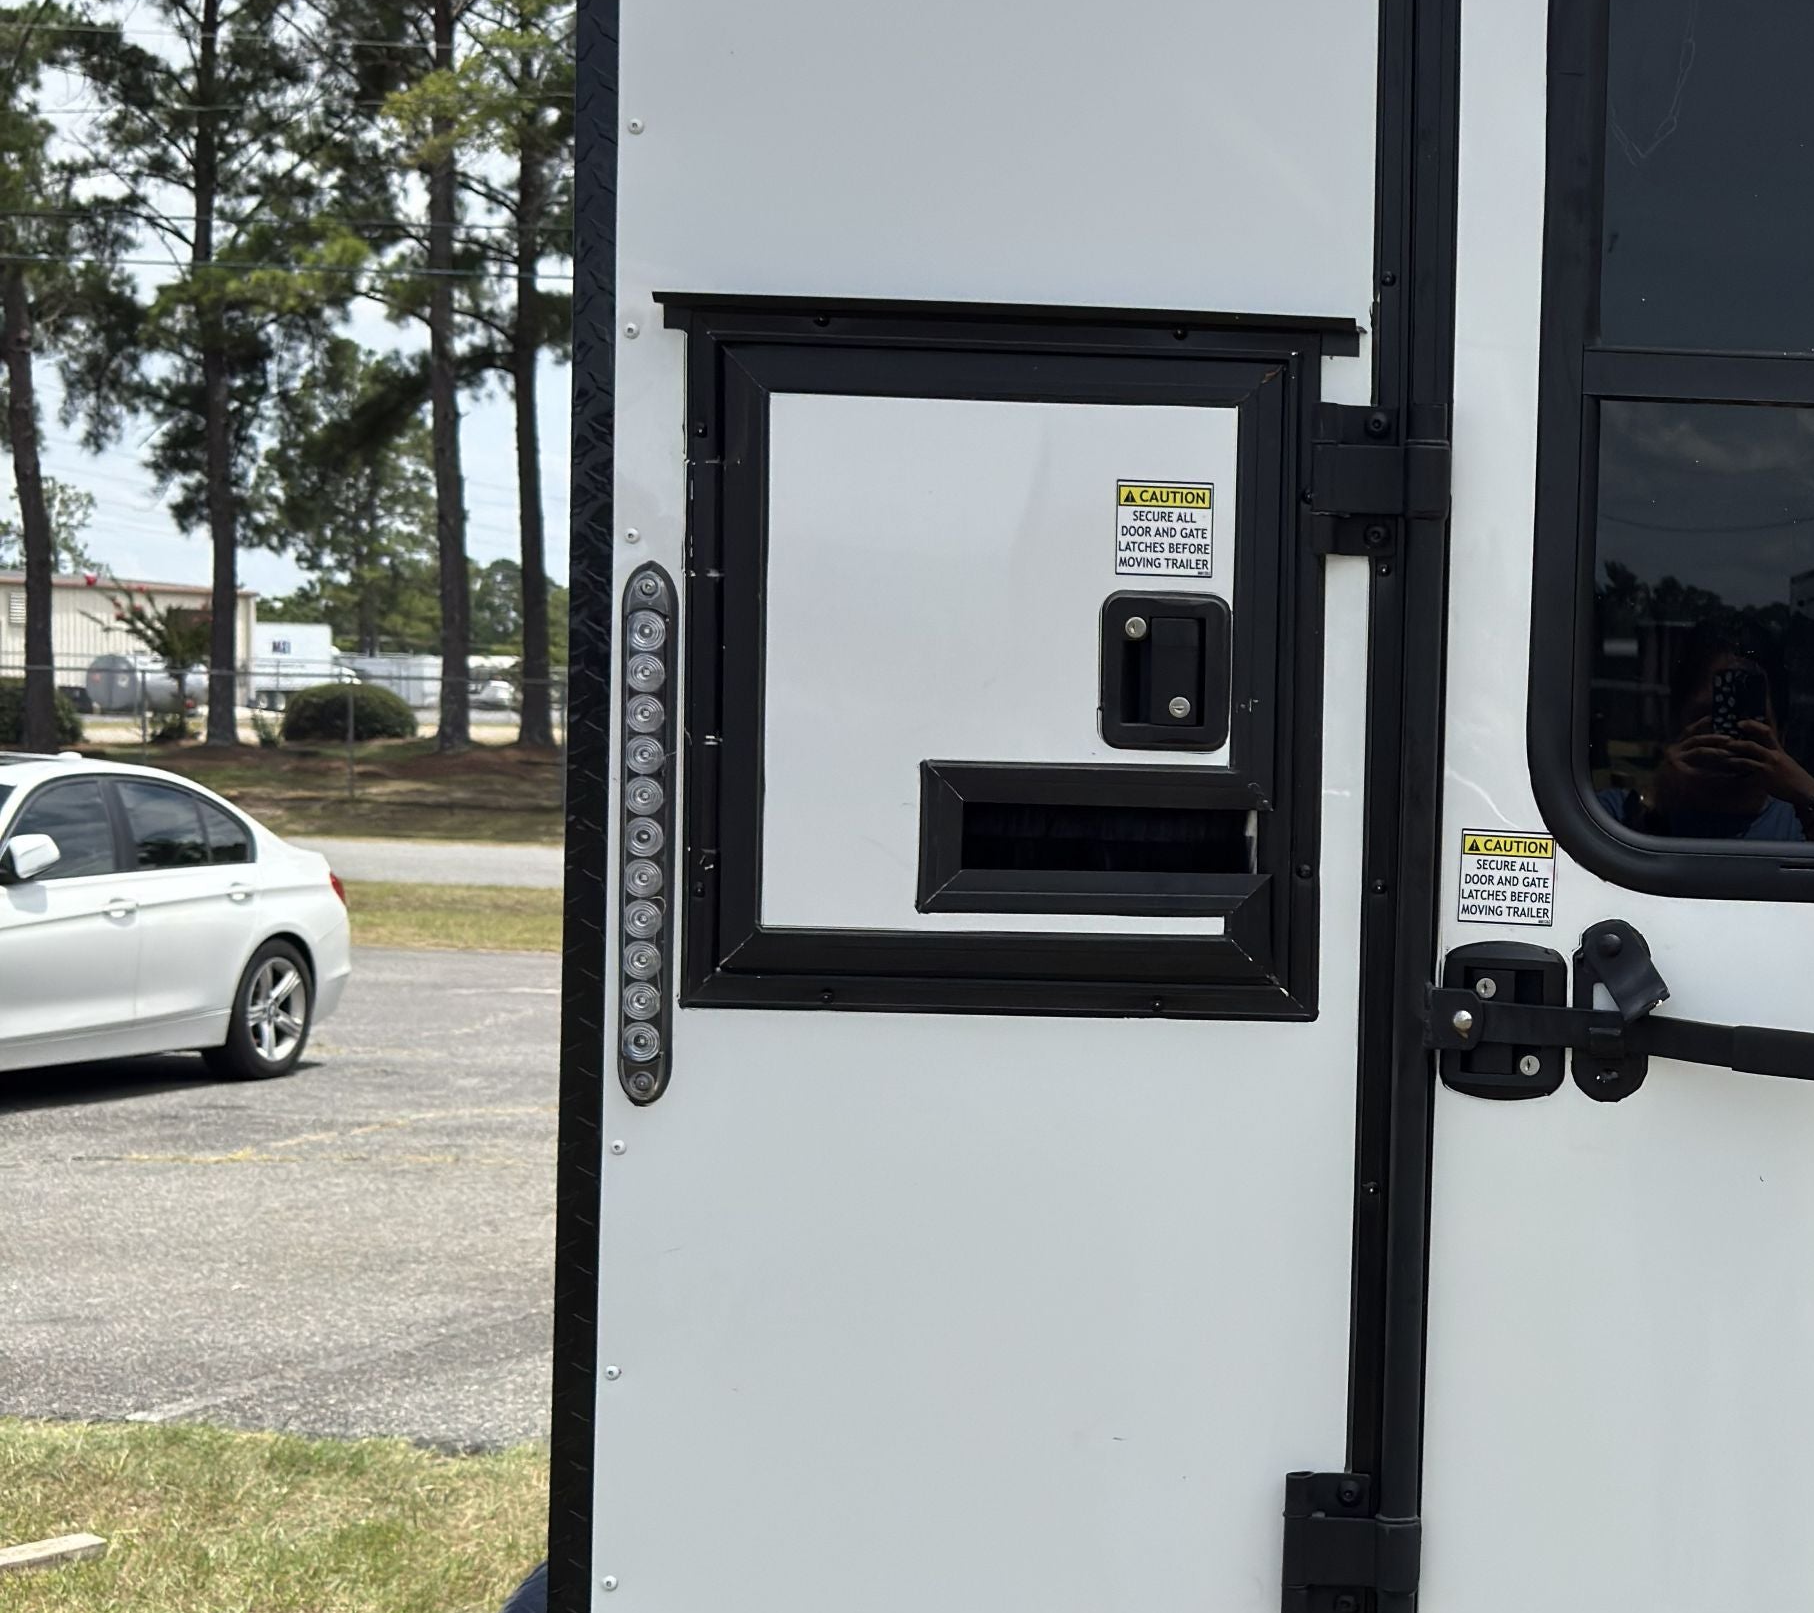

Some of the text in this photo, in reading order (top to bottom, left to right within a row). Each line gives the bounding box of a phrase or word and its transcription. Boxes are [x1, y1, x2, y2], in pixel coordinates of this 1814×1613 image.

[1139, 489, 1206, 504] CAUTION
[1133, 510, 1197, 523] SECURE ALL
[1121, 525, 1208, 539] DOOR AND GATE
[1118, 541, 1210, 555] LATCHES BEFORE
[1118, 556, 1209, 570] MOVING TRAILER
[1483, 838, 1549, 854] CAUTION
[1476, 858, 1539, 873] SECURE ALL
[1464, 873, 1550, 889] DOOR AND GATE
[1461, 889, 1551, 904] LATCHES BEFORE
[1460, 904, 1550, 919] MOVING TRAILER
